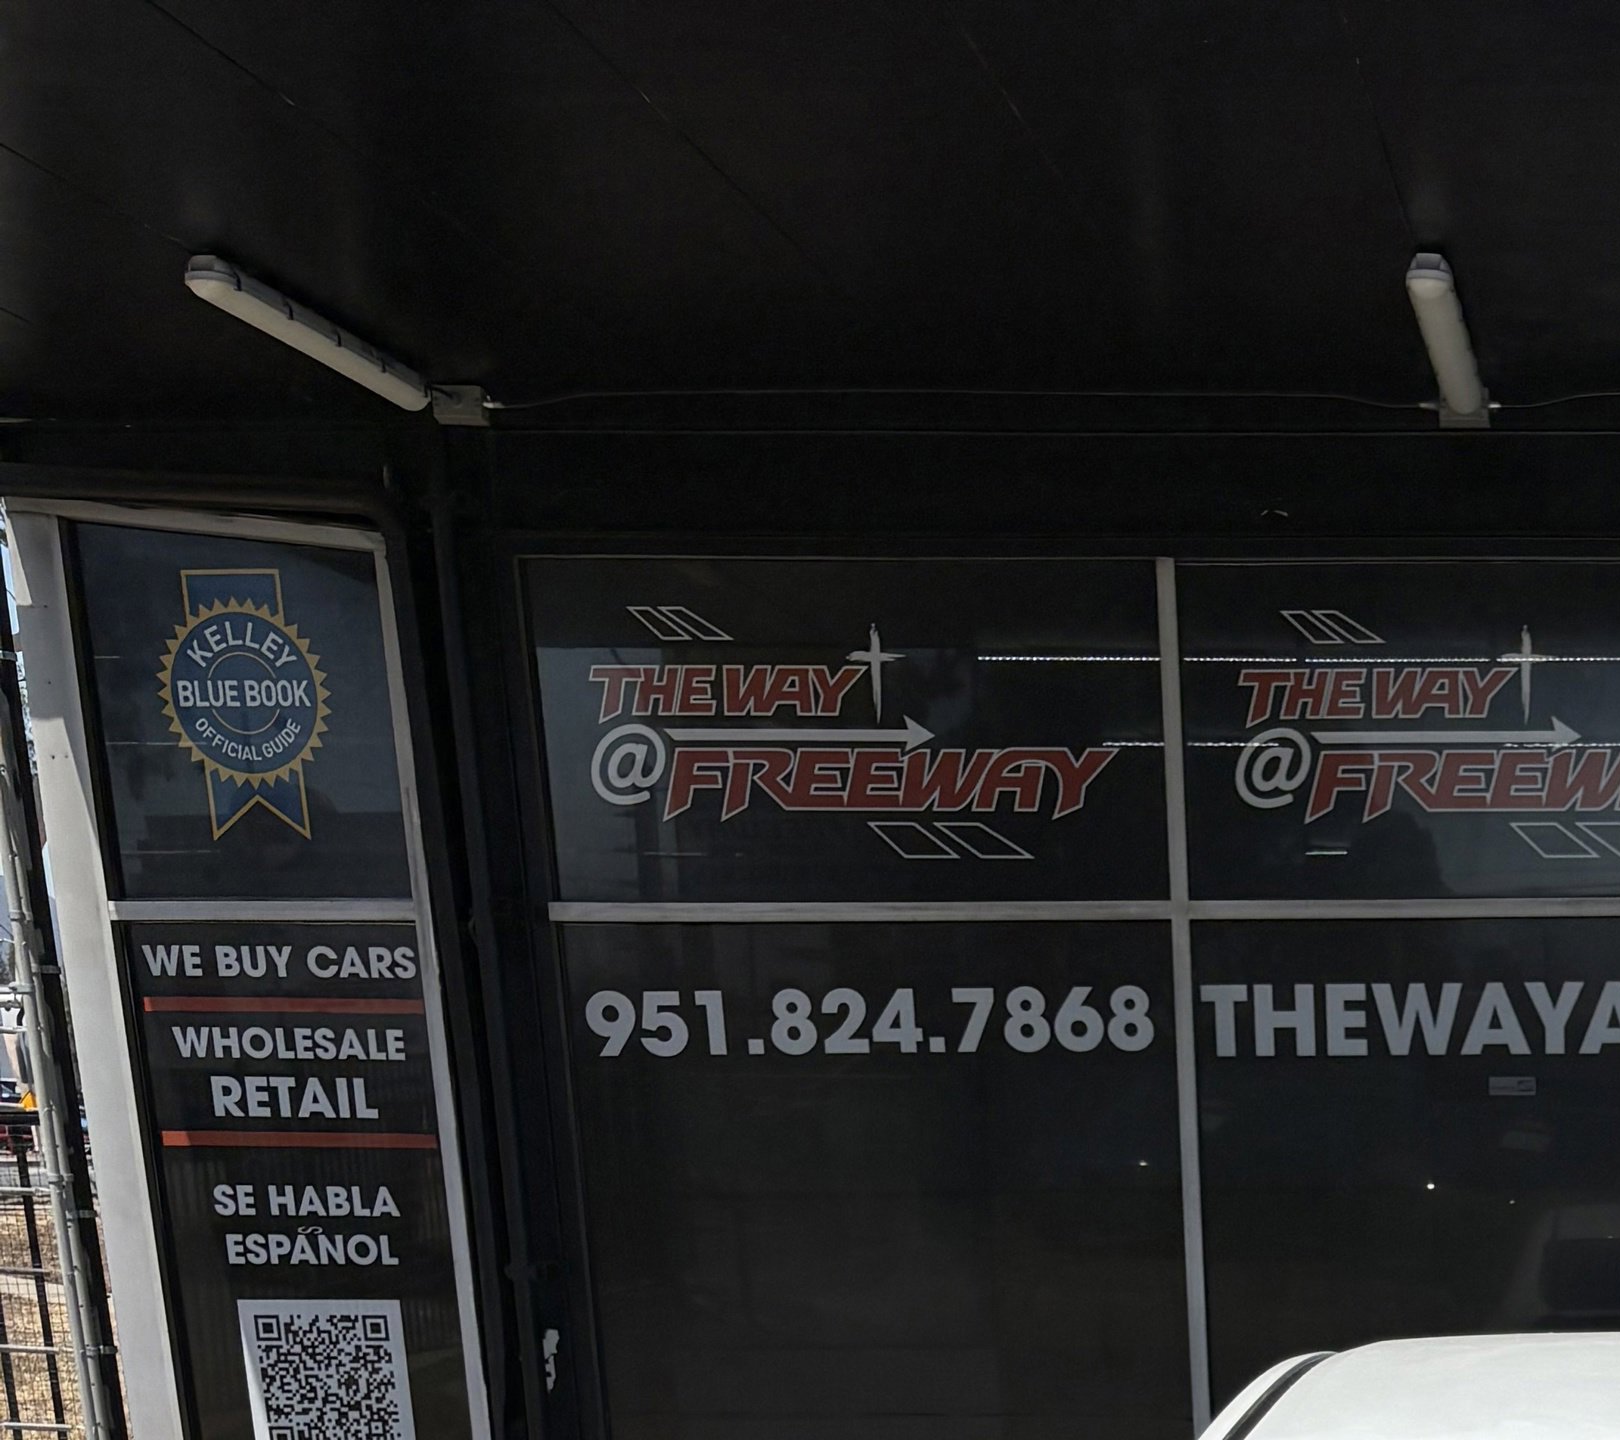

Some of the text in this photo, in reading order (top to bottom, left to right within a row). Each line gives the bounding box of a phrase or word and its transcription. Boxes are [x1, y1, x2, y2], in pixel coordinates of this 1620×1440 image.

[187, 621, 298, 669] KELLEY
[177, 679, 312, 708] BLUE BOOK
[194, 716, 302, 762] OFFICIAL GUIDE
[141, 944, 417, 979] WE BUY CARS
[585, 984, 1155, 1057] 951.824.7868
[171, 1026, 406, 1061] WHOLESALE
[209, 1075, 379, 1119] RETAIL
[213, 1184, 401, 1217] SE HABLA
